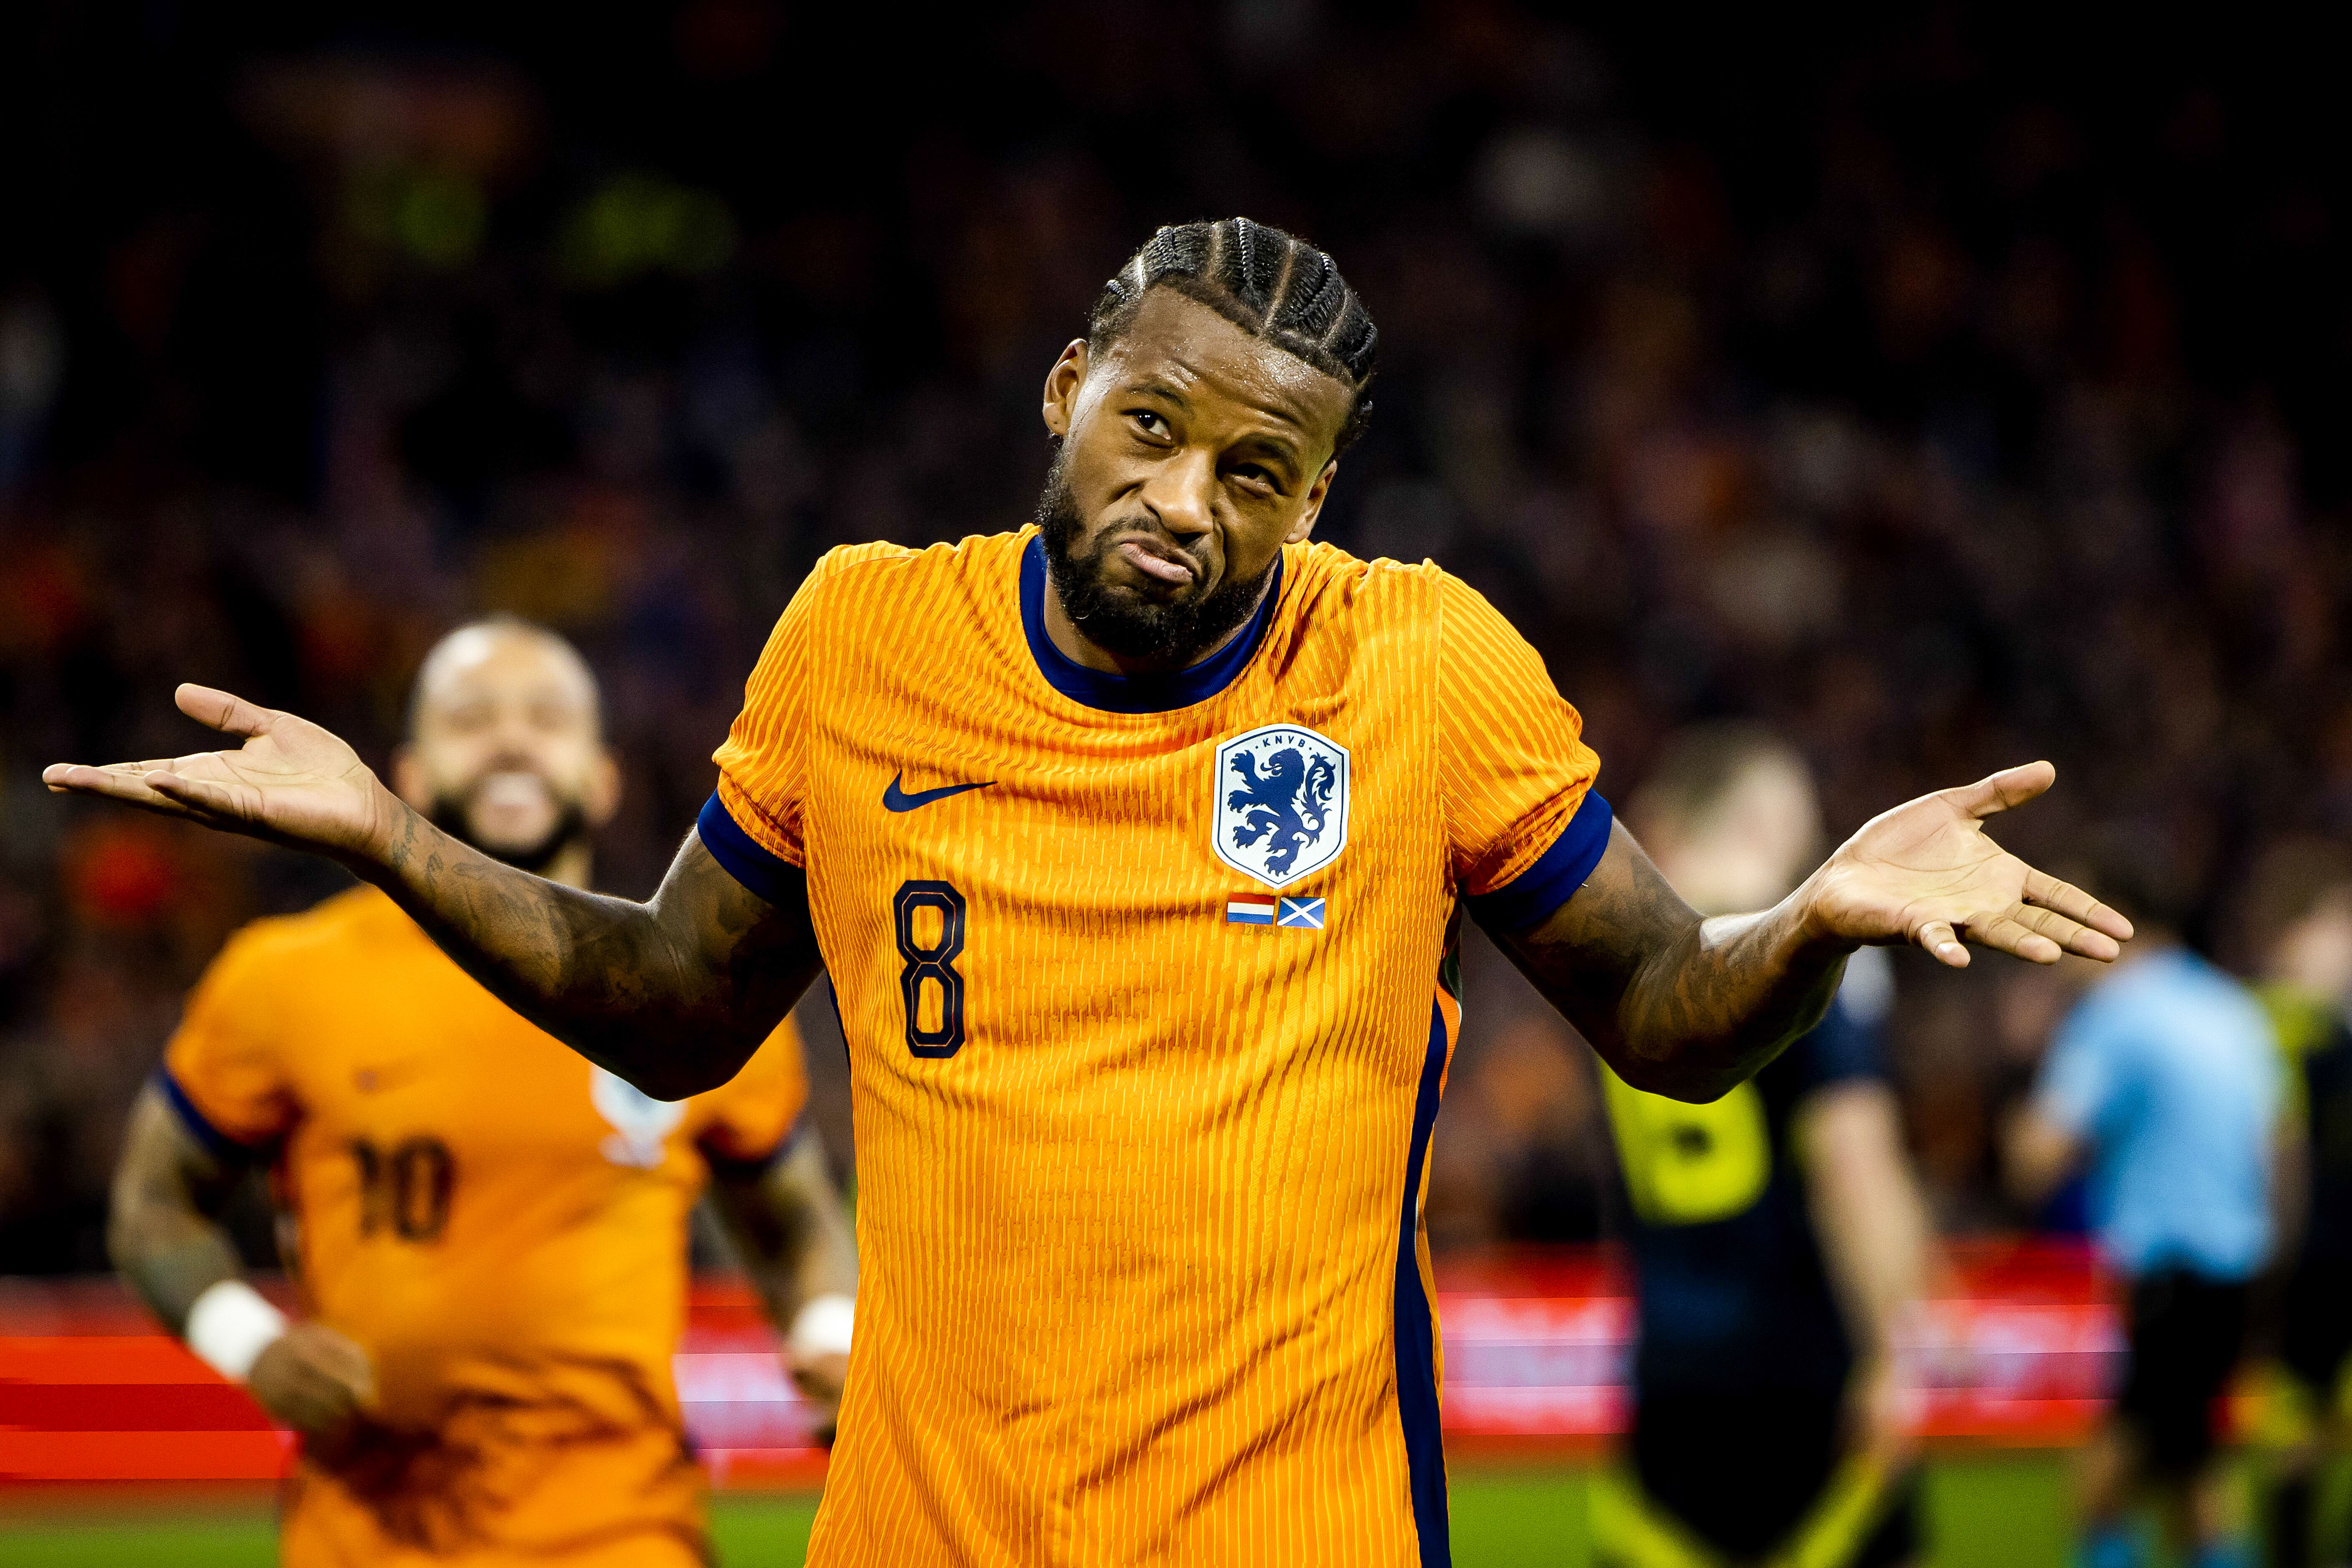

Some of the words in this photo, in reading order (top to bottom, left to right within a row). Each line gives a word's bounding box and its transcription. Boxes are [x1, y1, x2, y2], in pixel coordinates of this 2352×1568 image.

[1262, 735, 1305, 748] KNVB
[893, 880, 966, 1059] 8
[341, 1130, 456, 1246] 10
